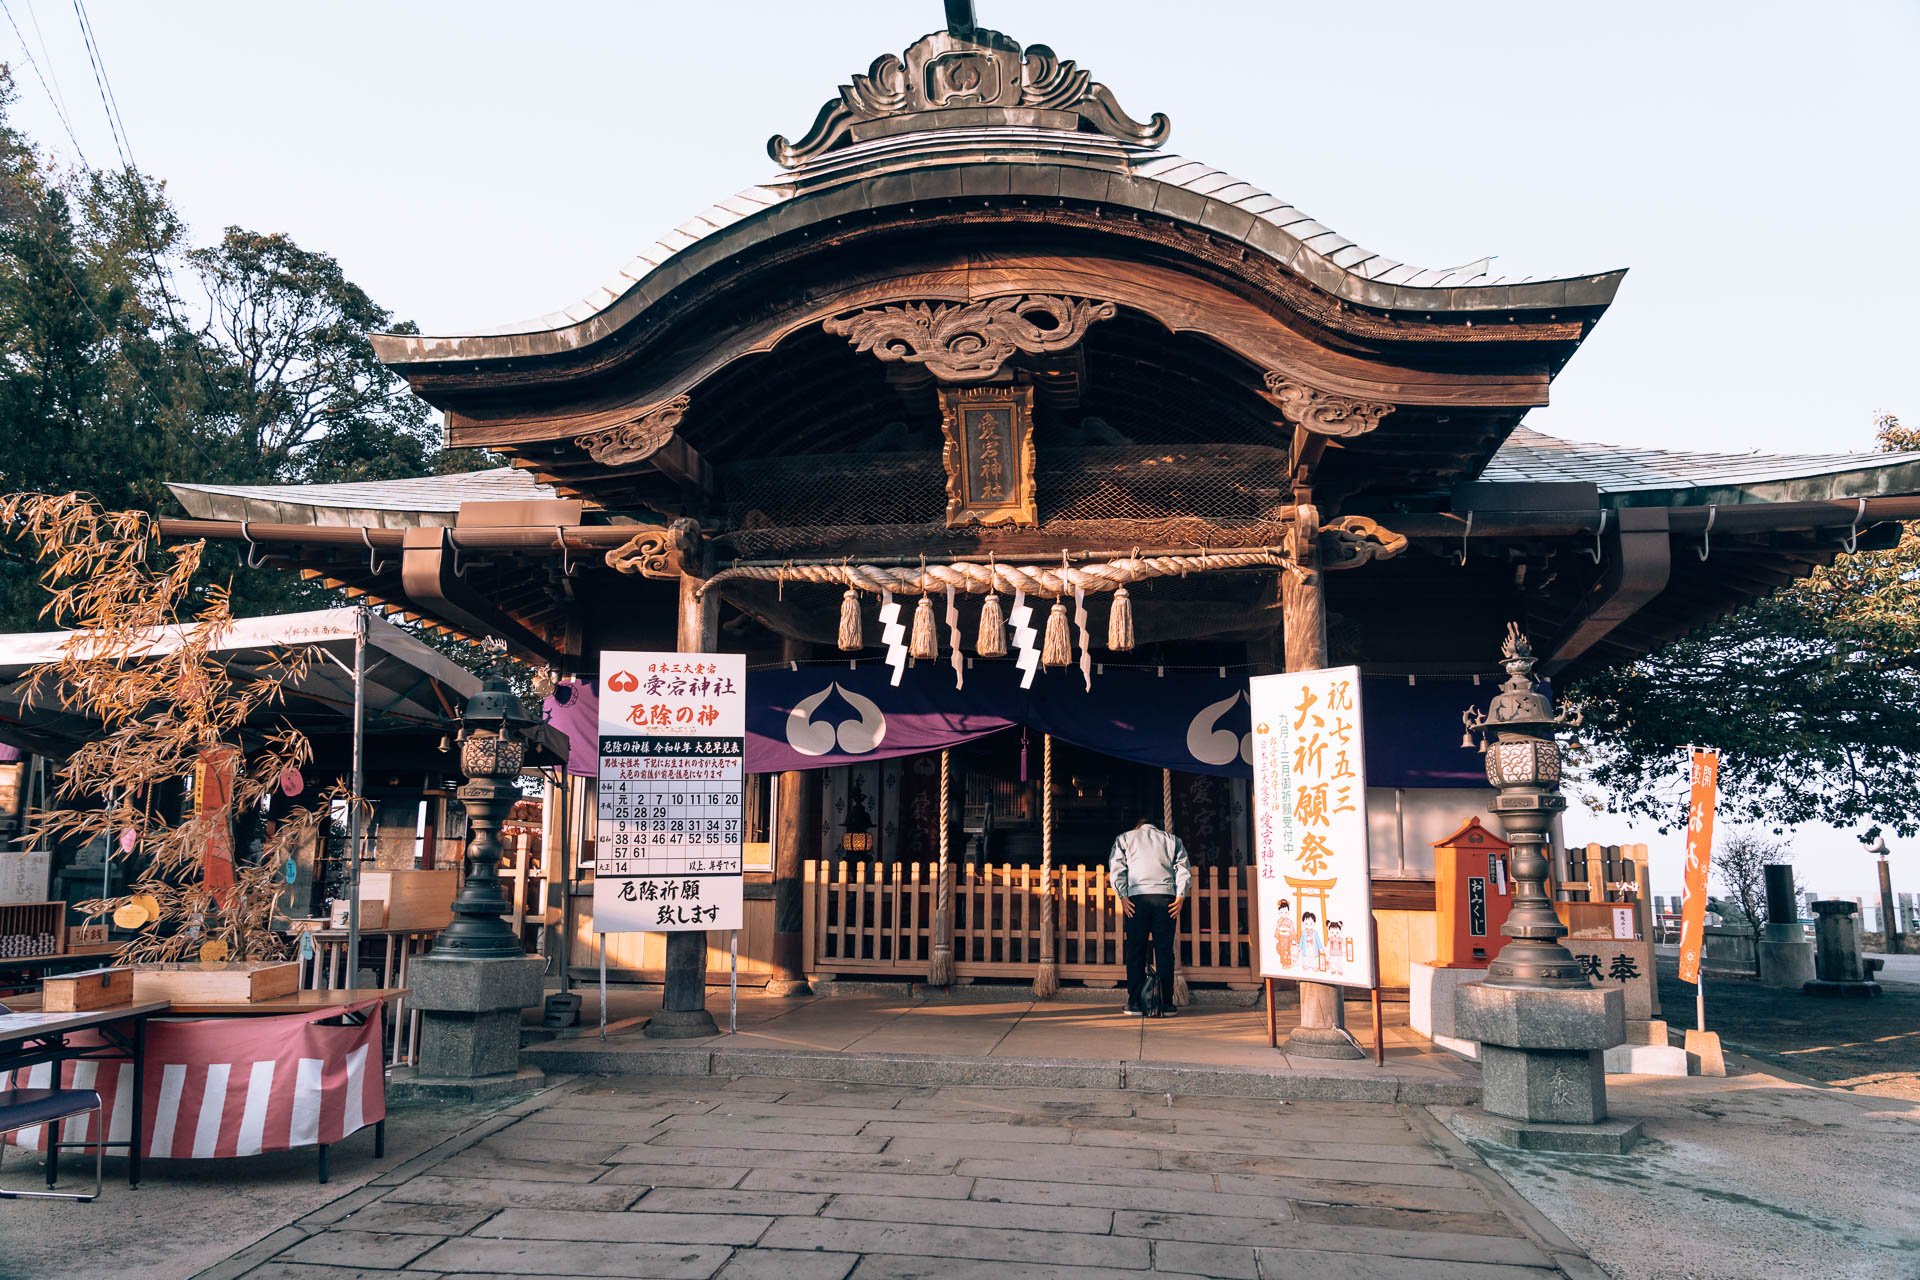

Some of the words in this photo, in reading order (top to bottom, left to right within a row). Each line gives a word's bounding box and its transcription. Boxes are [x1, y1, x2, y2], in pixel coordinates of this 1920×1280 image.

[977, 412, 1004, 499] 愛宕神社
[648, 663, 717, 675] 日本三大愛宕
[643, 674, 737, 697] 愛宕神社
[625, 703, 720, 727] 厄除の神
[603, 741, 650, 754] 厄除の神様
[653, 741, 692, 754] 令和4年
[694, 741, 740, 754] 大厄早見表
[1327, 680, 1356, 814] 祝七五三
[619, 782, 627, 792] 4
[1293, 685, 1335, 877] 大祈願祭
[618, 795, 628, 805] 元
[638, 795, 644, 805] 2
[656, 795, 663, 805] 7
[672, 795, 684, 805] 10
[690, 795, 701, 805] 11
[708, 795, 719, 805] 16
[725, 795, 739, 805] 20
[615, 808, 629, 818] 25
[634, 808, 648, 818] 28
[653, 808, 666, 818] 29
[619, 821, 626, 831] 9
[635, 821, 647, 831] 18
[652, 821, 666, 831] 23
[670, 821, 684, 831] 28
[688, 821, 700, 831] 31
[706, 821, 720, 831] 34
[724, 821, 738, 831] 37
[615, 834, 628, 844] 38
[633, 834, 647, 844] 43
[652, 834, 666, 844] 46
[670, 834, 683, 844] 47
[688, 834, 702, 844] 52
[706, 834, 720, 844] 55
[724, 834, 738, 844] 56
[1260, 811, 1275, 880] 愛宕神社
[614, 848, 628, 858] 57
[633, 848, 645, 858] 61
[599, 863, 610, 871] 大正
[615, 862, 628, 872] 14
[617, 879, 701, 902] 厄除祈願
[656, 905, 720, 925] 致します
[1471, 880, 1483, 934] おみくじ
